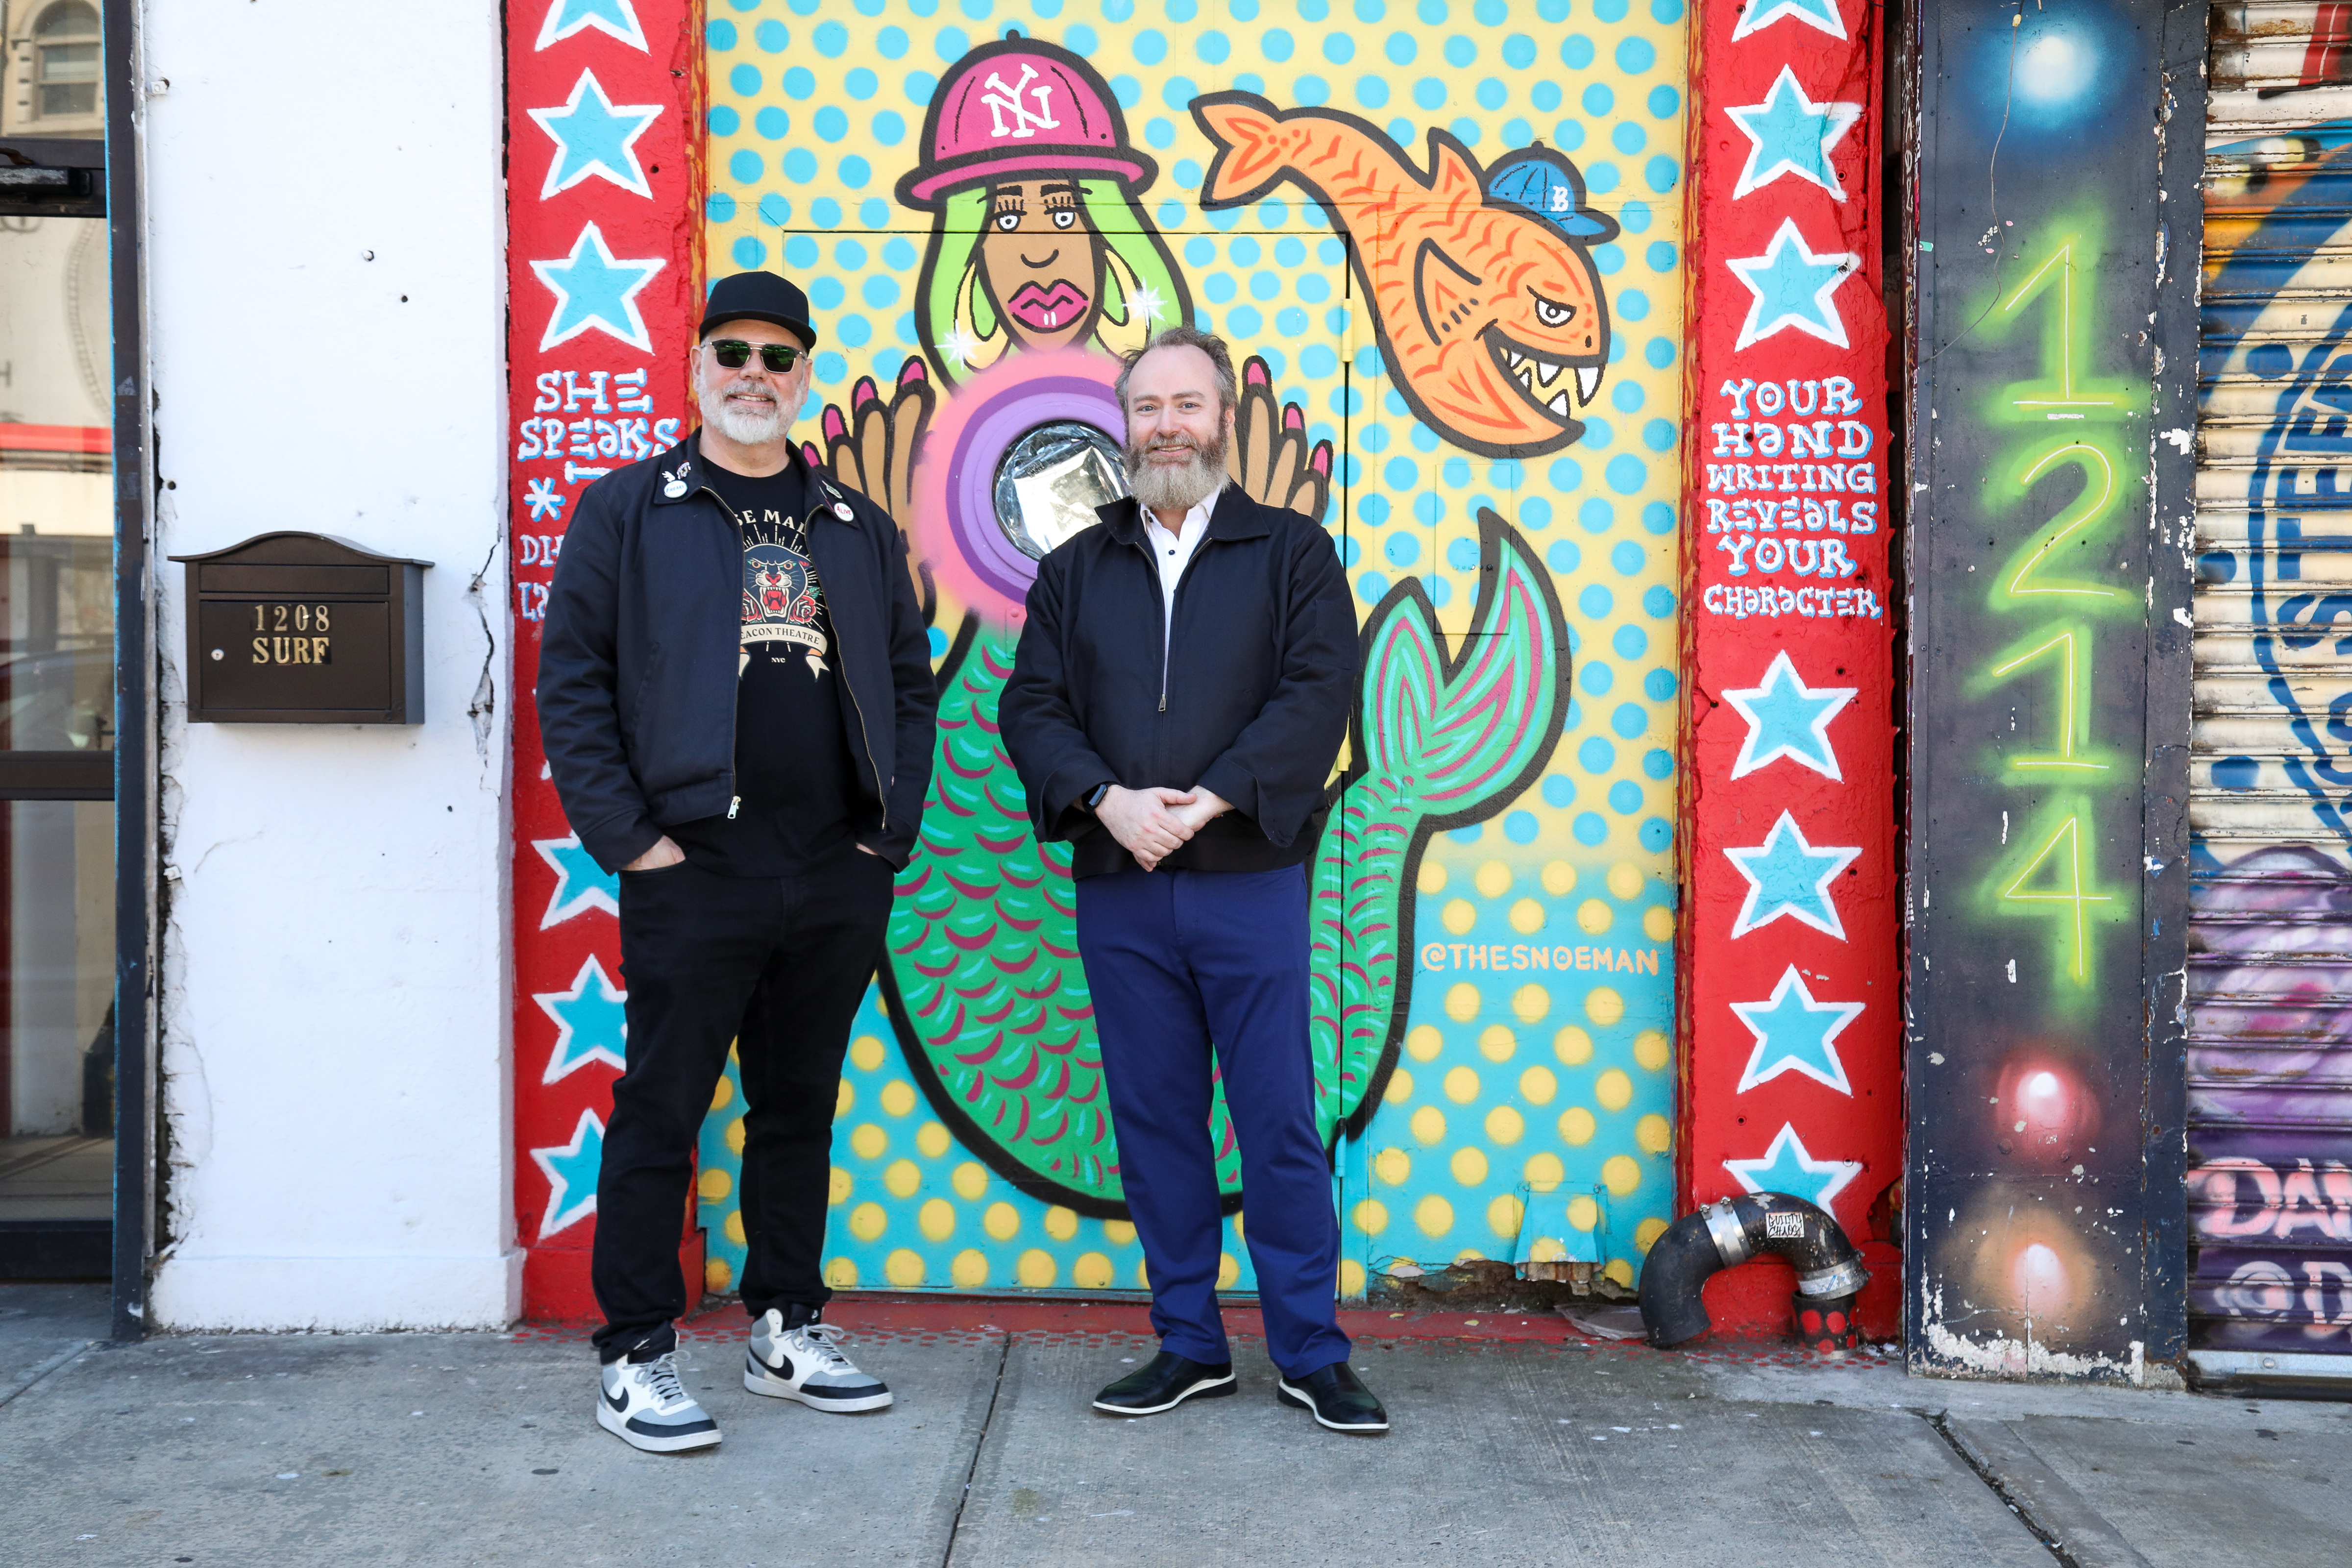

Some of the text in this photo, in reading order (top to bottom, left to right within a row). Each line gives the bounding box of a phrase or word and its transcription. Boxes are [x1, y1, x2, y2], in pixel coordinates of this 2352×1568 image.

[1550, 185, 1569, 212] B
[534, 368, 654, 413] SHE
[1719, 375, 1863, 420] YOUR
[1706, 462, 1878, 495] WRITING
[1716, 534, 1858, 579] YOUR
[253, 604, 330, 632] 1208
[252, 637, 330, 664] SURF
[775, 628, 820, 645] THEATRE
[1421, 942, 1659, 976] @THESNOEMAN
